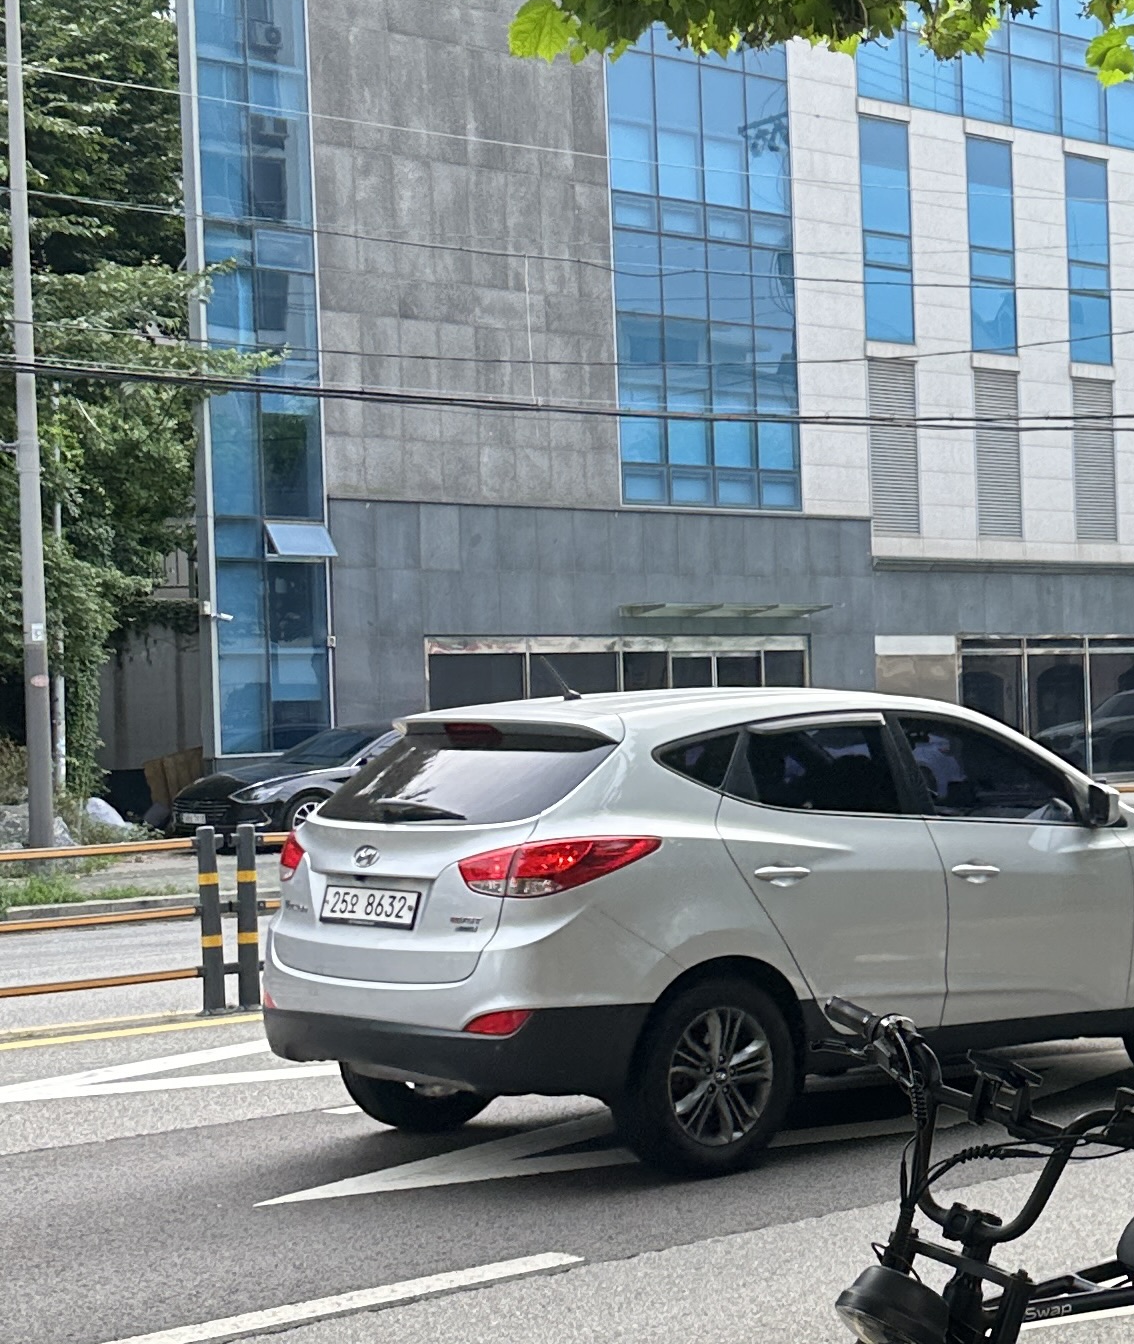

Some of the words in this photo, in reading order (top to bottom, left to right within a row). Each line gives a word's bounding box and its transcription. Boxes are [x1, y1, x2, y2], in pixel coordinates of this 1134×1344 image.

[329, 891, 359, 914] 25오
[364, 893, 408, 919] 8632
[1024, 1303, 1072, 1321] Swap
